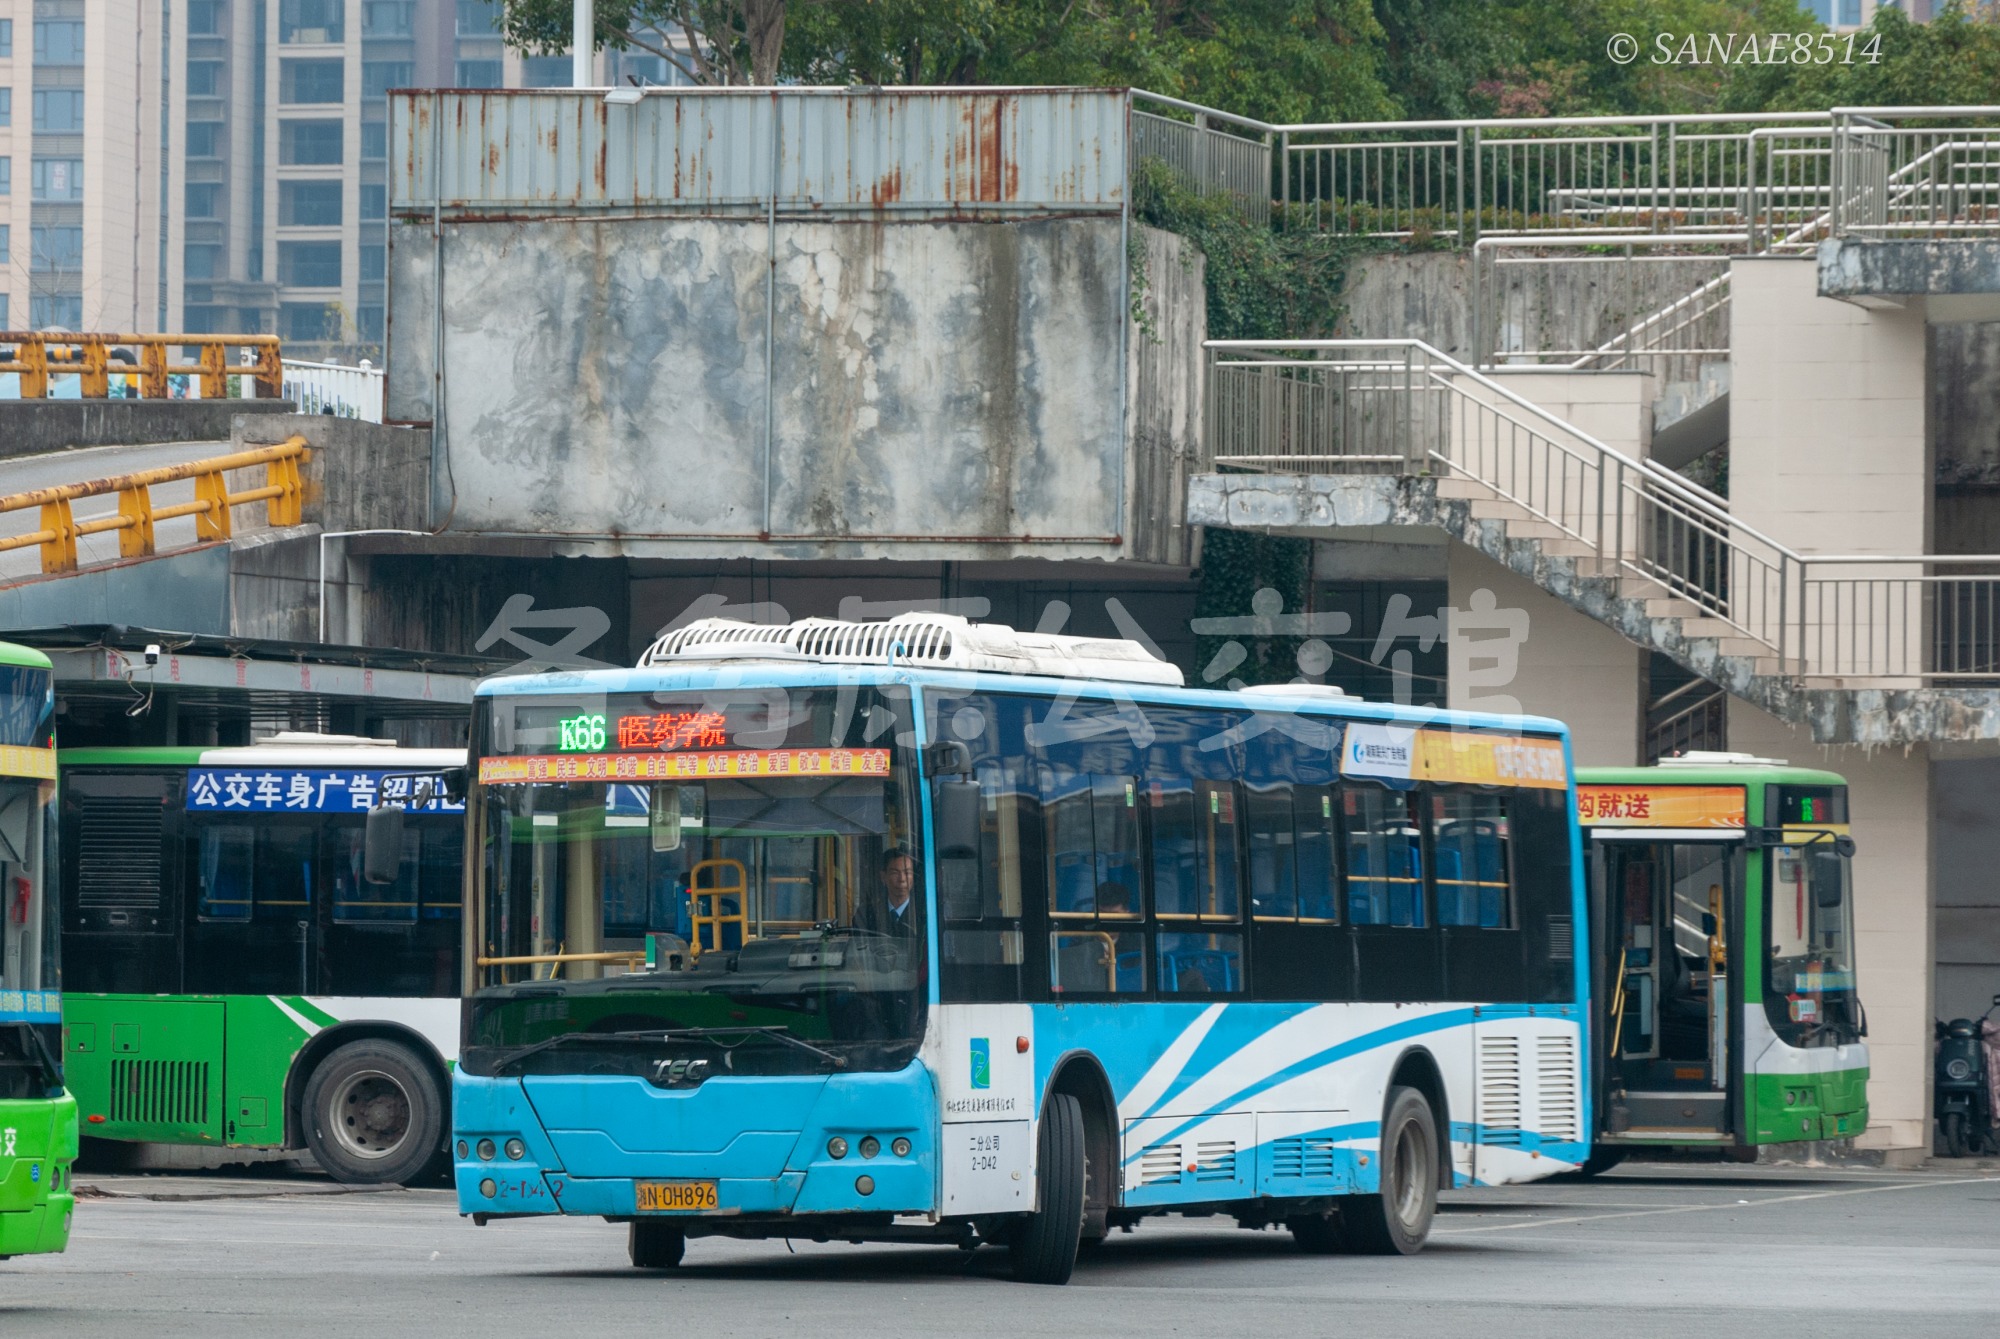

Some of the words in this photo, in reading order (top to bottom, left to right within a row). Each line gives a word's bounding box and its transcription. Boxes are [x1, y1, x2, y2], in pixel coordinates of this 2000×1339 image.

[560, 716, 606, 750] K66
[527, 758, 548, 779] 富强
[556, 758, 578, 779] 民主
[586, 757, 607, 778] 文明
[616, 756, 638, 778] 和谐
[646, 756, 667, 778] 自由
[676, 755, 698, 775] 平等
[707, 755, 728, 774] 公正
[736, 753, 759, 774] 法治
[768, 752, 790, 773] 爱国
[799, 752, 821, 772] 敬业
[830, 751, 853, 771] 诚信
[862, 750, 886, 773] 友善
[1577, 792, 1650, 819] 购就送
[0, 1127, 17, 1156] 交
[970, 1135, 999, 1151] 二分公司
[972, 1155, 997, 1170] 2-D42
